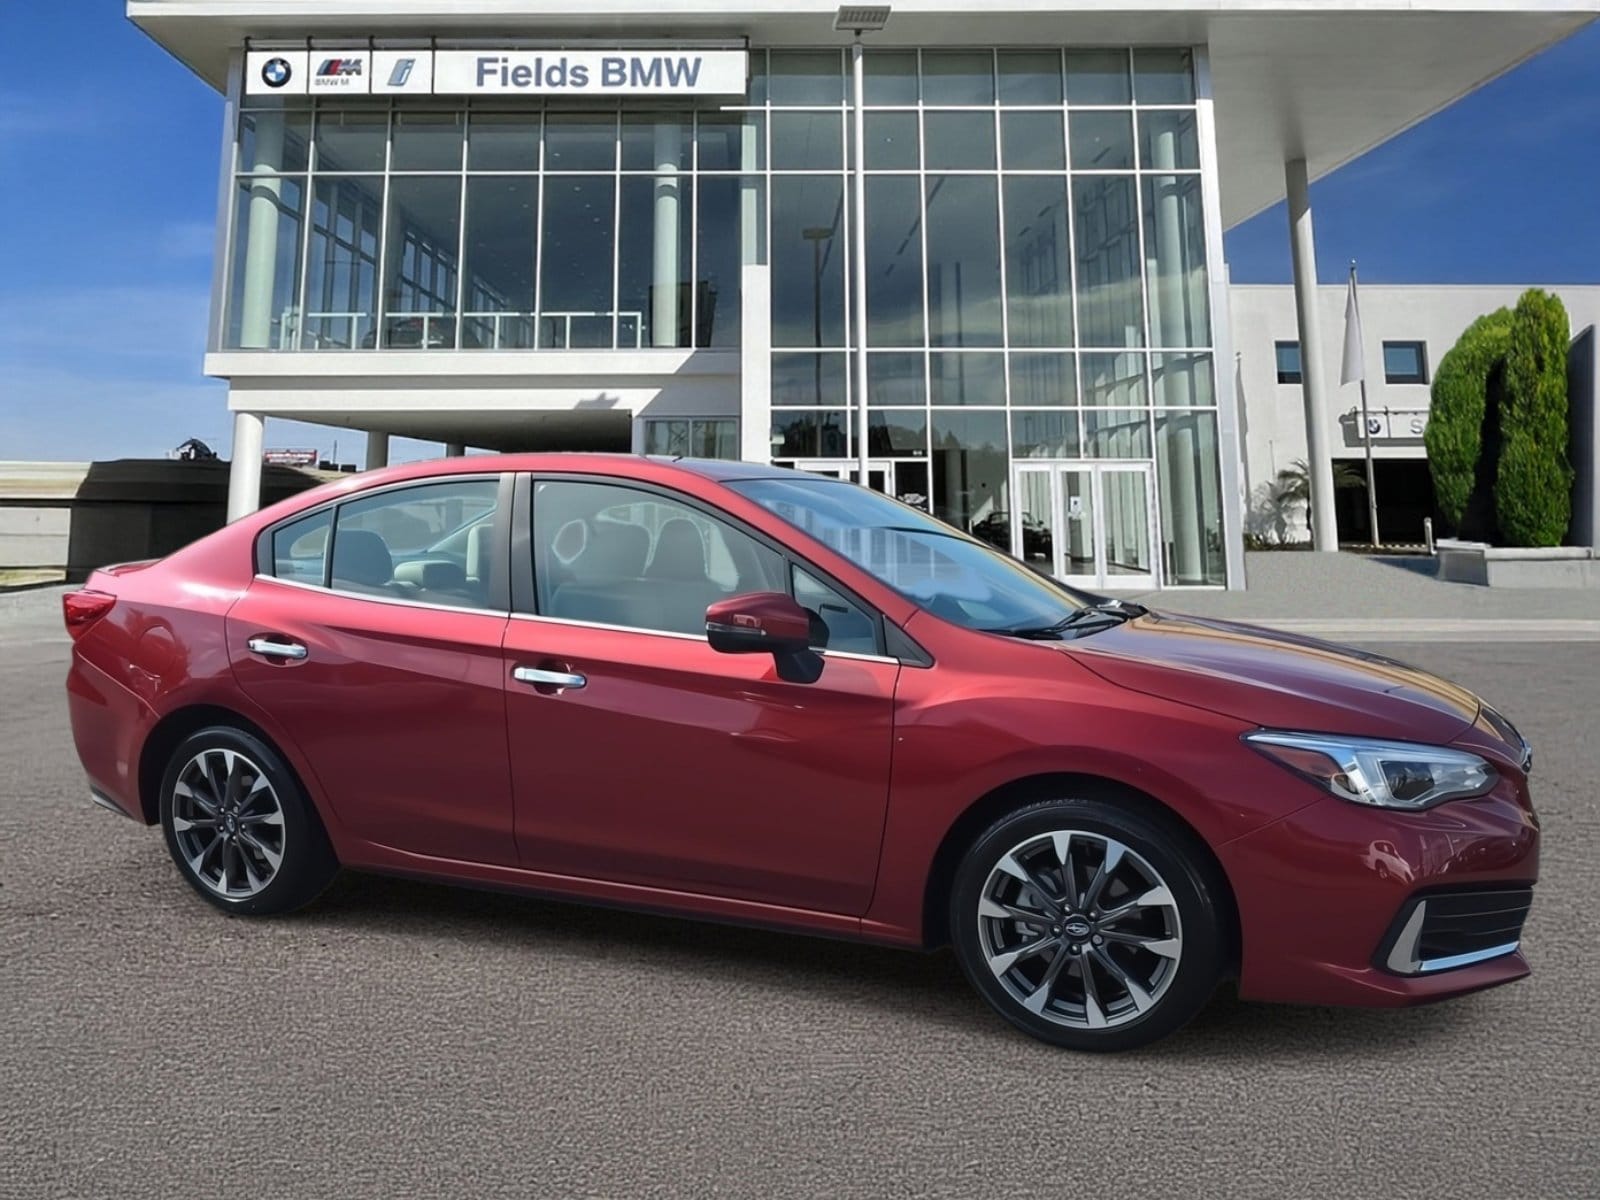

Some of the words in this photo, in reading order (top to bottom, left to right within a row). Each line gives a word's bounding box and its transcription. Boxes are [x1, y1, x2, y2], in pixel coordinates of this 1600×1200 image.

[476, 57, 589, 87] Fields
[601, 57, 702, 87] BMW
[1410, 418, 1424, 435] S
